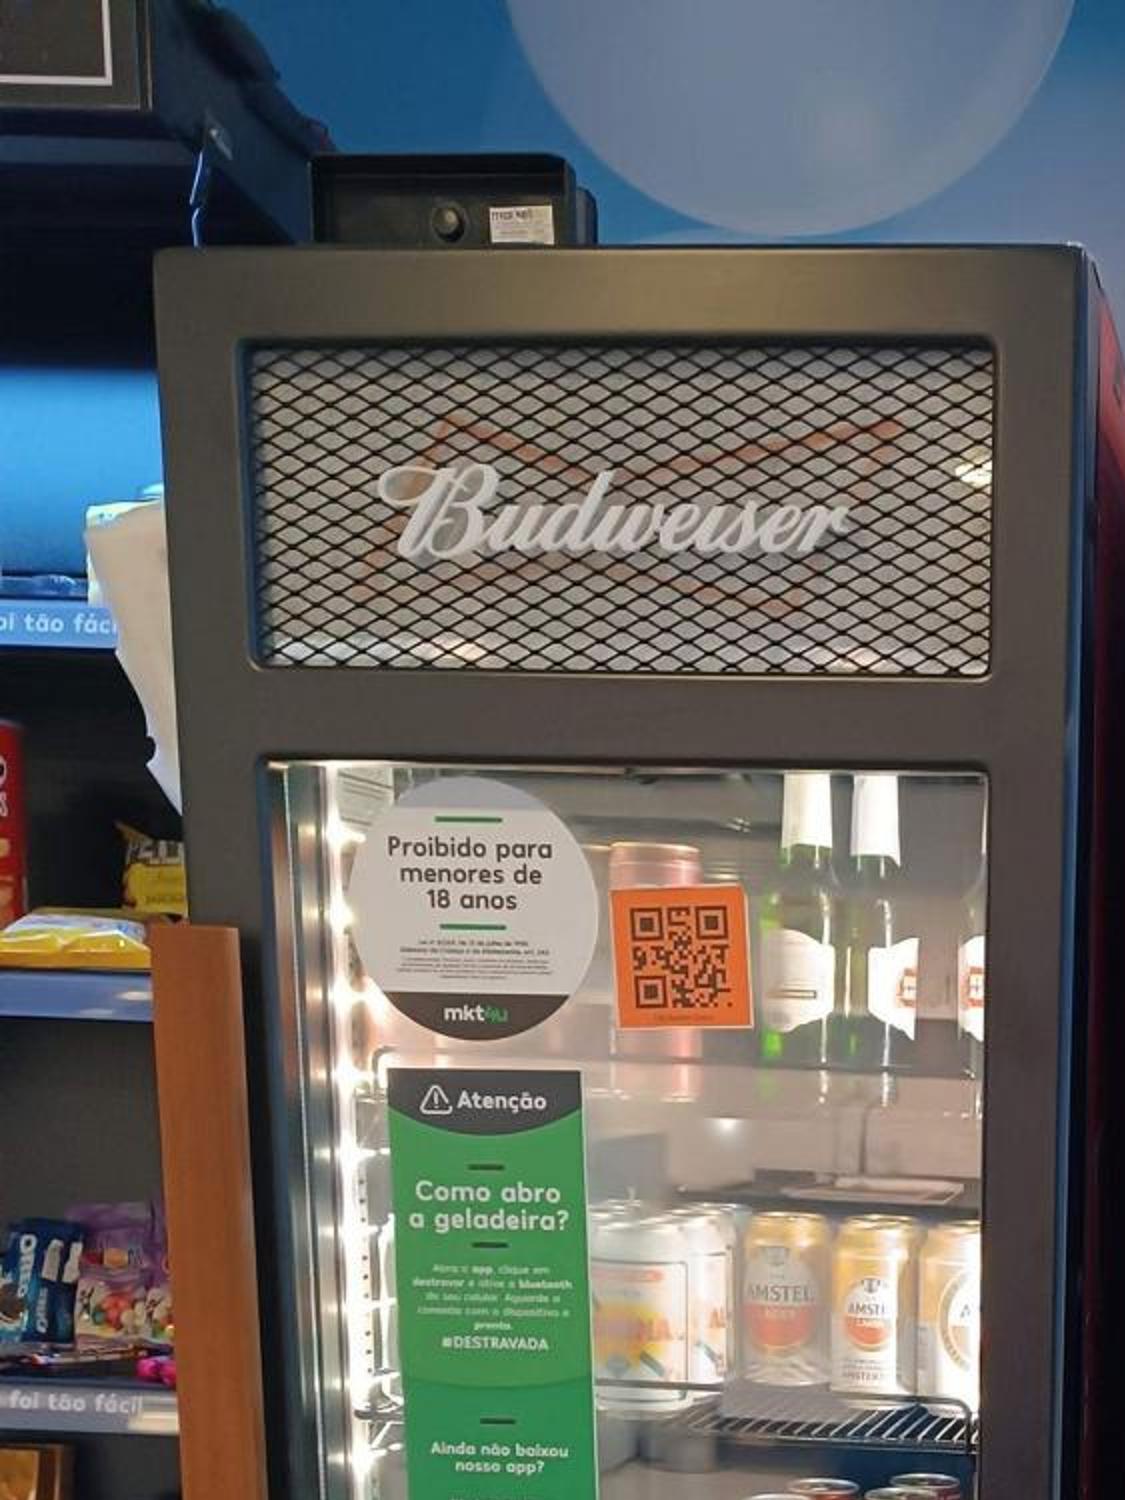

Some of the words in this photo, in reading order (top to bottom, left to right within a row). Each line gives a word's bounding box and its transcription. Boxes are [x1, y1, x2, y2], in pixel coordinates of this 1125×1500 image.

[378, 463, 849, 558] Budweiser
[24, 612, 65, 632] tão
[387, 836, 486, 858] Proibido
[496, 841, 553, 861] para
[400, 867, 504, 885] menores
[513, 863, 543, 885] de
[427, 889, 450, 909] 18
[460, 894, 517, 910] anos
[457, 1090, 547, 1113] Atenção
[415, 1179, 490, 1203] Como
[501, 1181, 561, 1203] abro
[409, 1212, 424, 1229] a
[435, 1207, 570, 1234] geladeira?
[48, 1392, 87, 1412] tão
[431, 1441, 476, 1456] Ainda
[481, 1442, 511, 1457] não
[515, 1443, 569, 1458] baixou
[455, 1460, 501, 1473] nosso
[505, 1460, 545, 1476] app?
